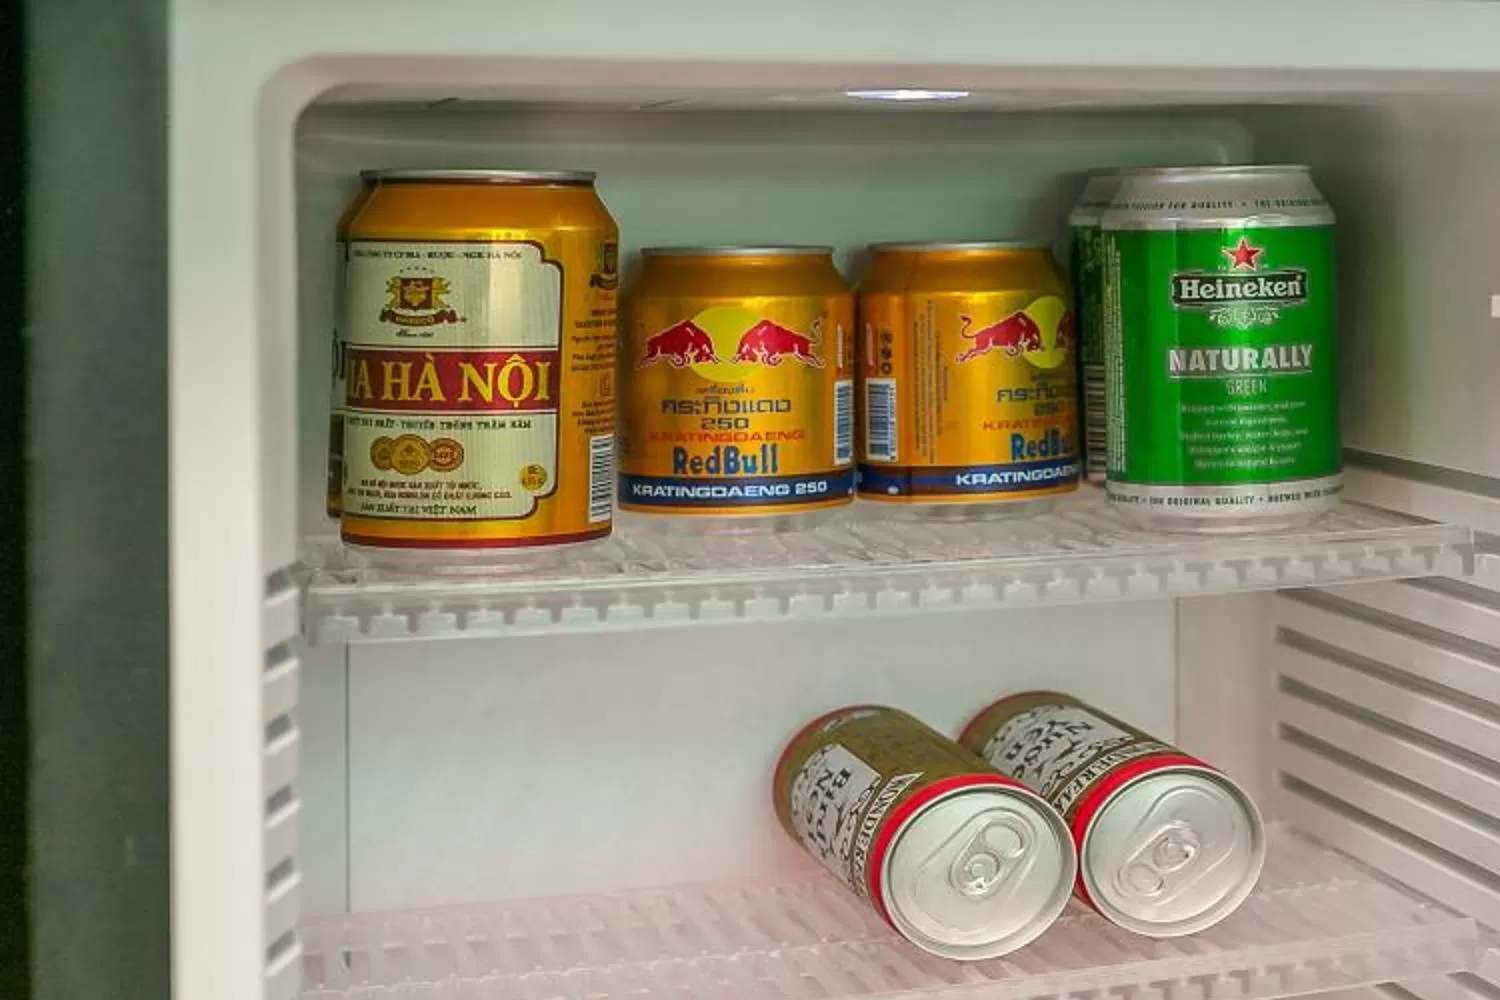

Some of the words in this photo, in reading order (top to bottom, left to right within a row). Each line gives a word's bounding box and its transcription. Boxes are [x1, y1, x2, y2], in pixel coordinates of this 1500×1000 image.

[1179, 274, 1303, 300] Heineken
[1168, 343, 1313, 372] NATURALLY
[380, 352, 446, 401] HÀ
[458, 352, 551, 408] NỘI
[650, 429, 806, 444] KRATINGDAENG
[701, 417, 749, 431] 250
[672, 443, 779, 475] RedBull
[631, 483, 791, 498] KRATINGDAENG
[795, 481, 828, 496] 250
